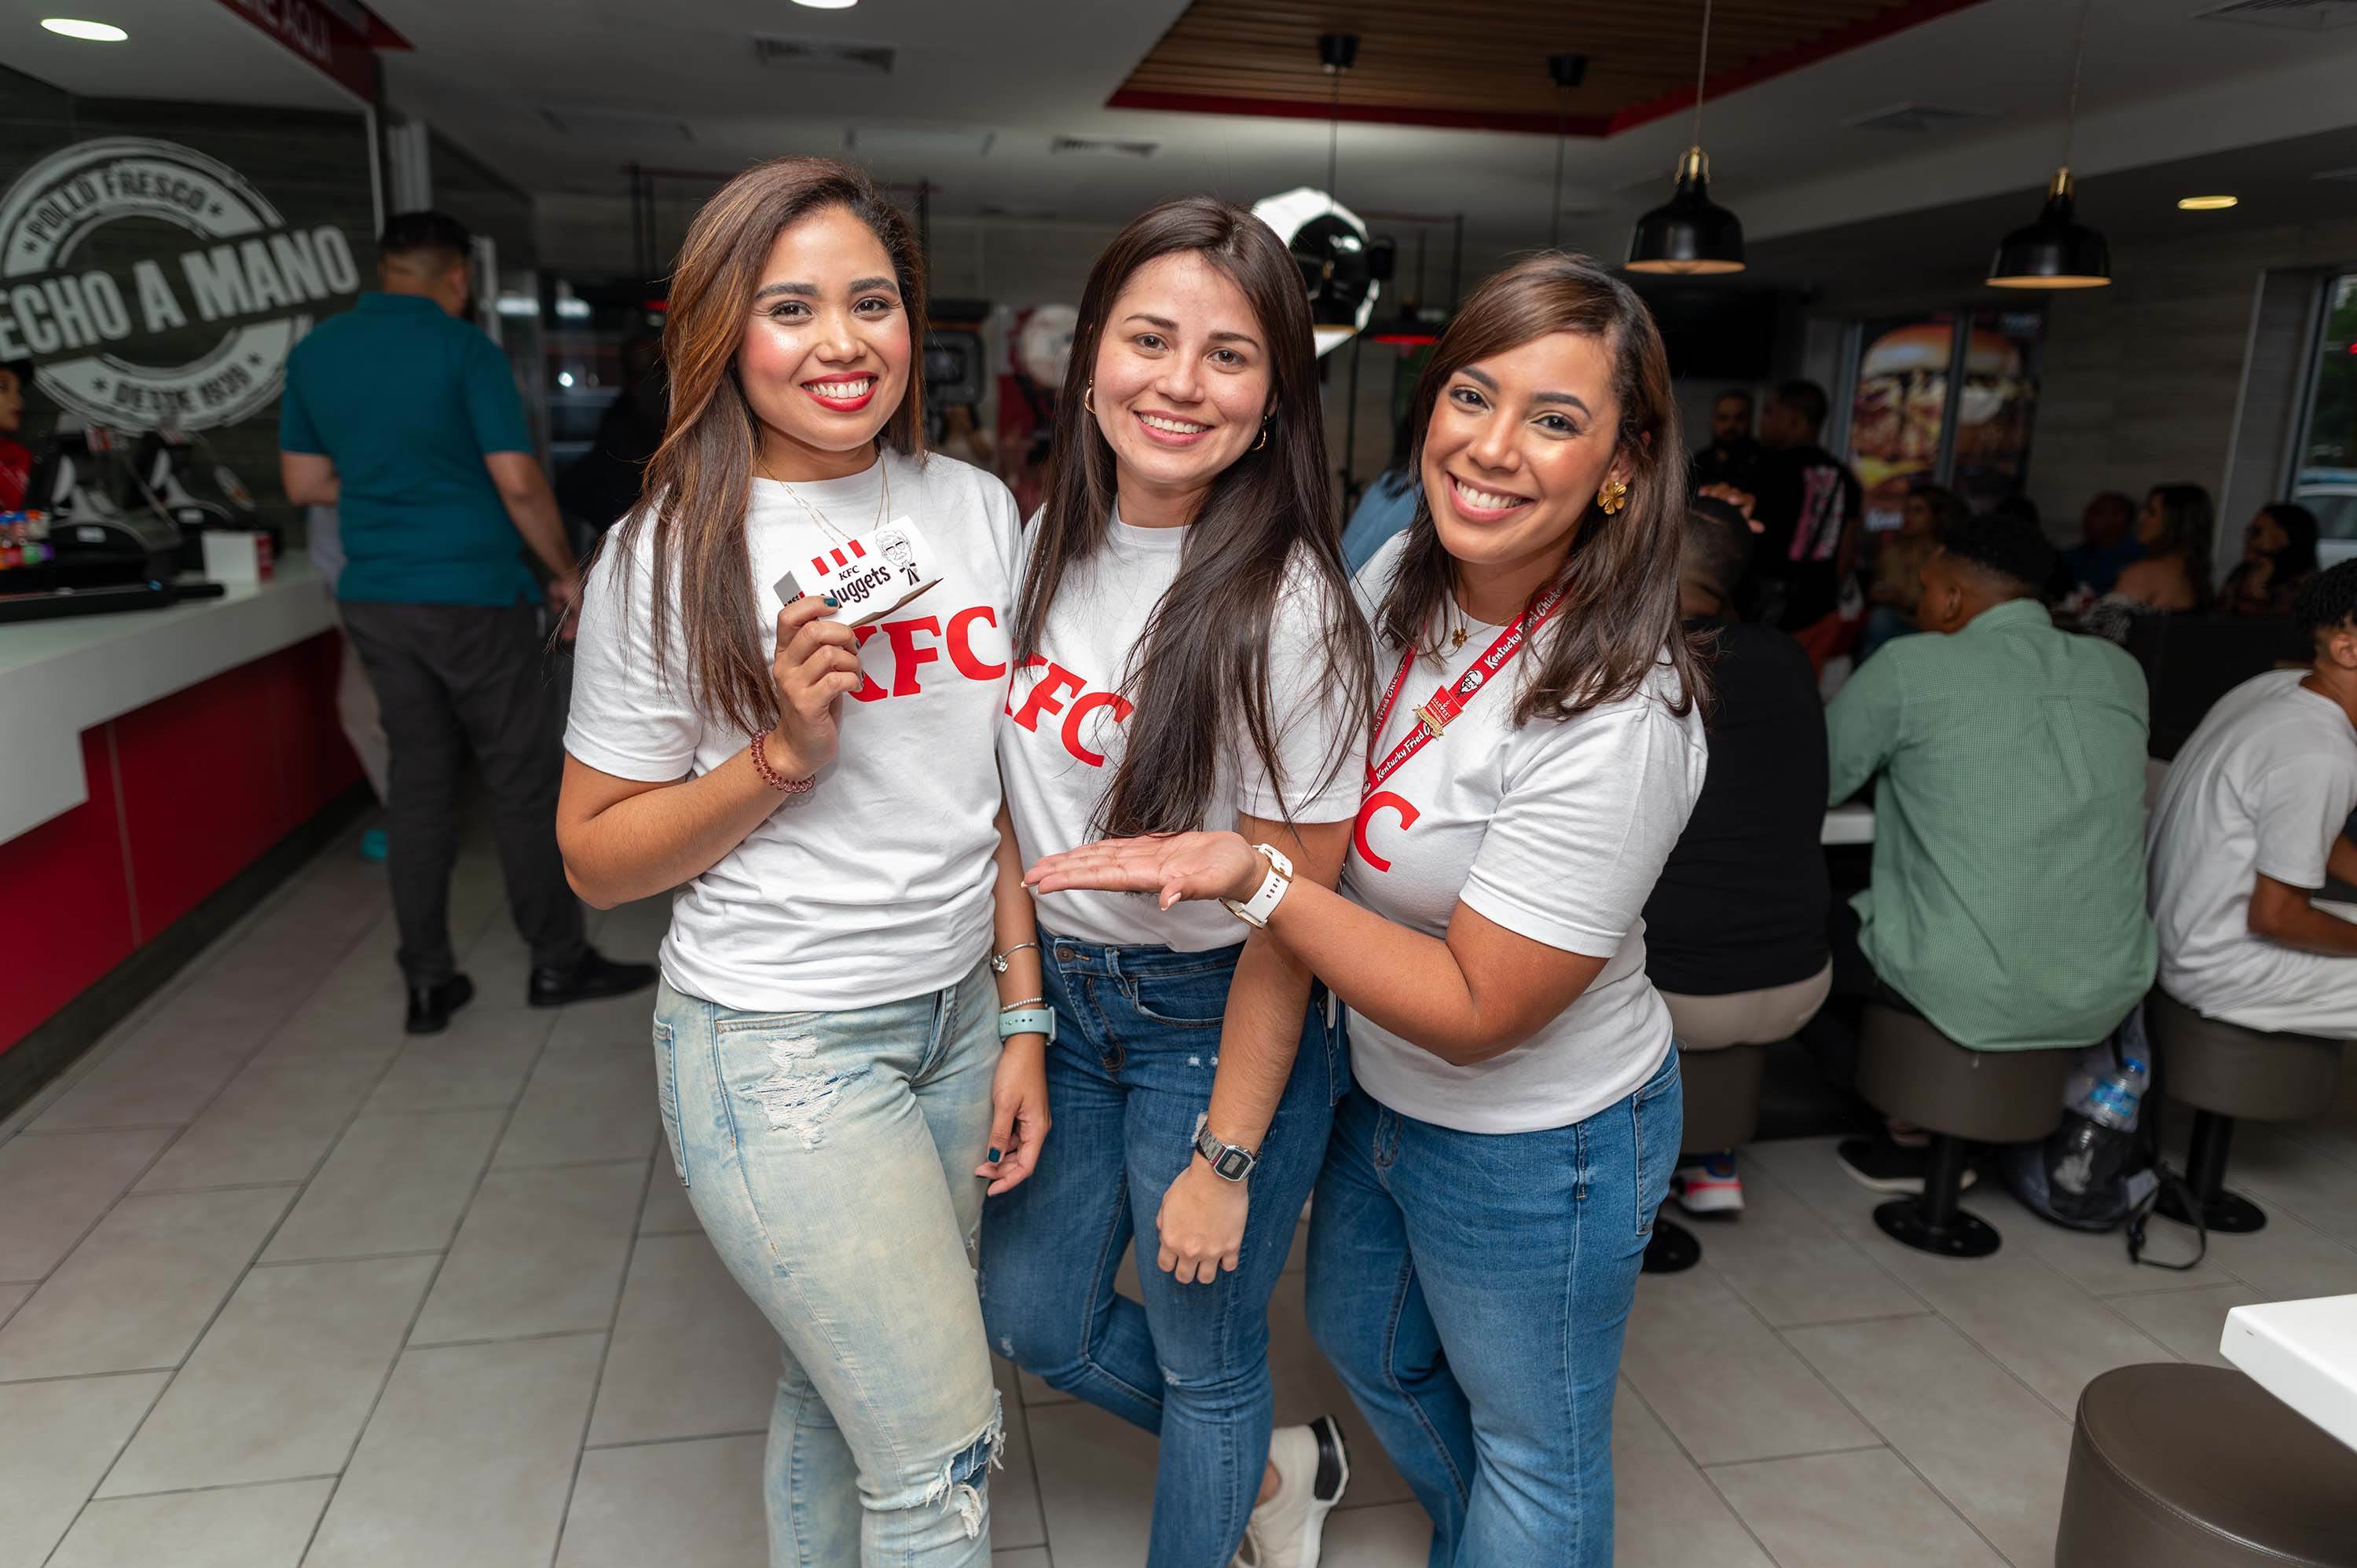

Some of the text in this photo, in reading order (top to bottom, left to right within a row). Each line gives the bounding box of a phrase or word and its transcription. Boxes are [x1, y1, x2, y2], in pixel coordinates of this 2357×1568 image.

[26, 170, 206, 245] POLLO FRESCO
[133, 258, 187, 333] A
[179, 225, 360, 321] MANO
[838, 565, 860, 581] KFC
[1484, 632, 1522, 669] Kentucky
[1431, 697, 1452, 718] HARVEST
[1376, 729, 1425, 782] Kentucky Fried
